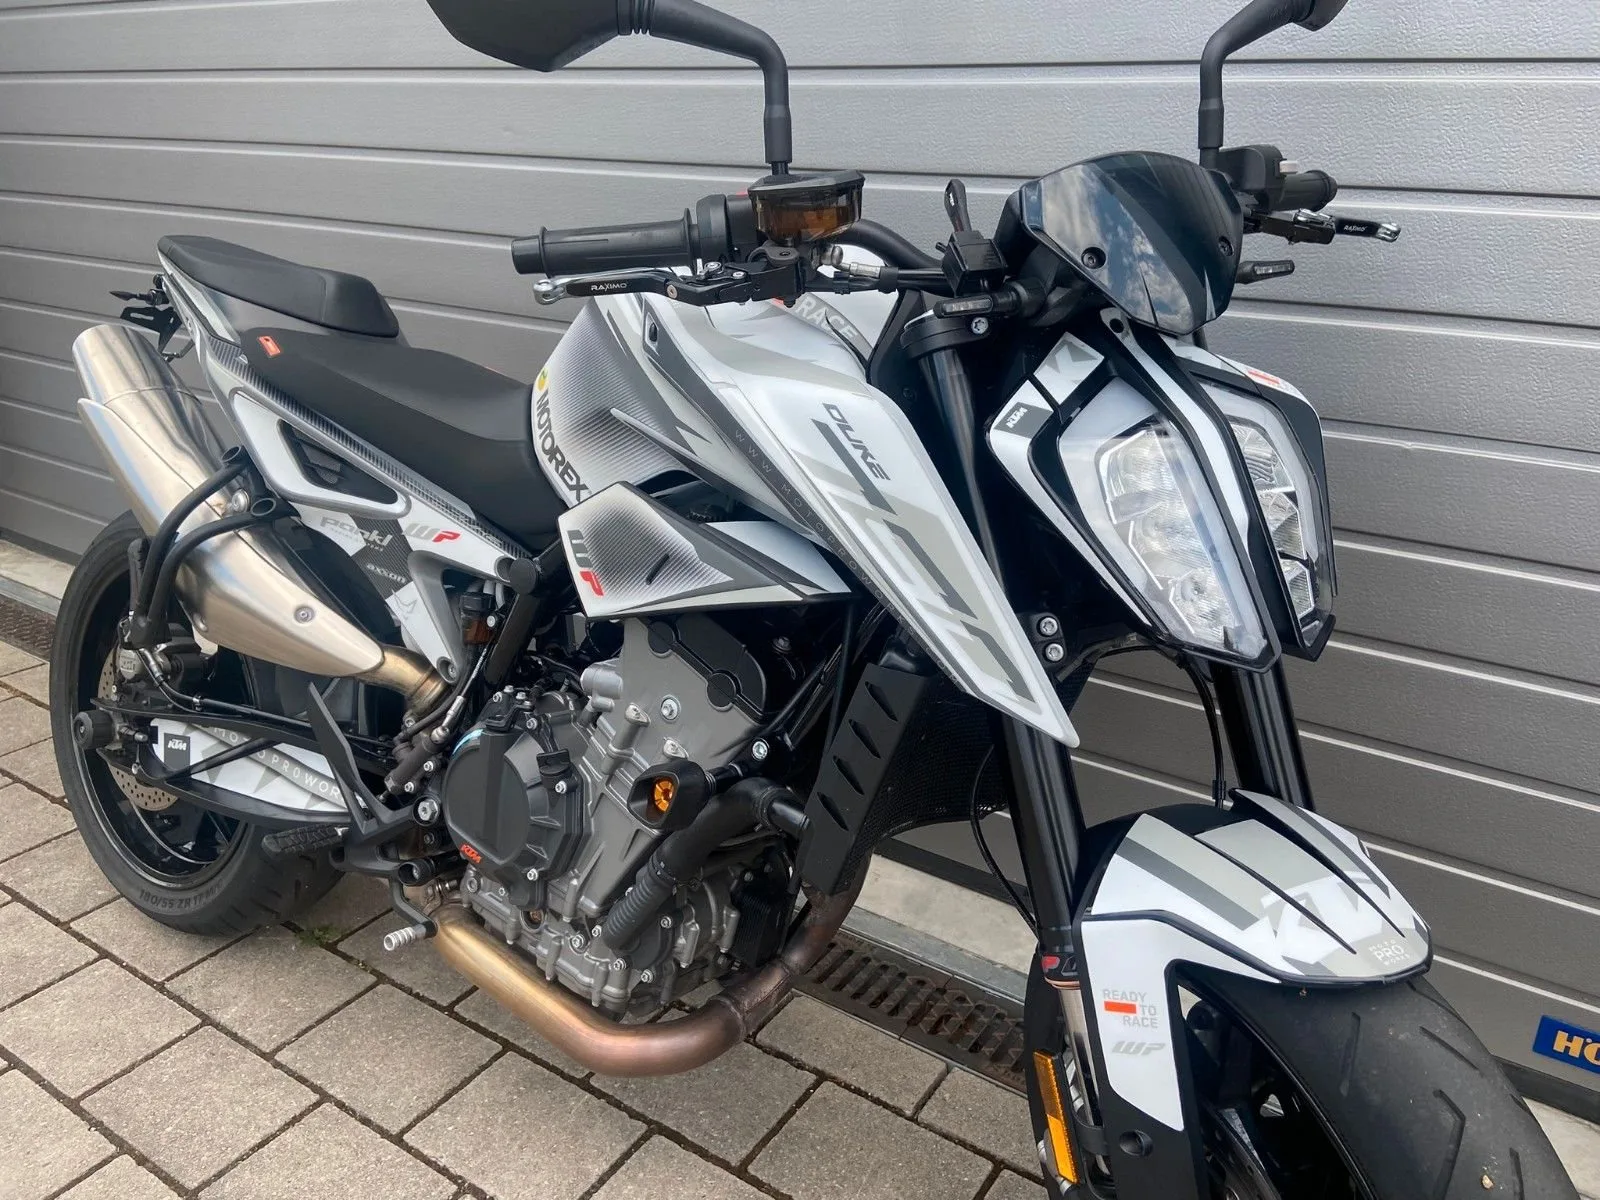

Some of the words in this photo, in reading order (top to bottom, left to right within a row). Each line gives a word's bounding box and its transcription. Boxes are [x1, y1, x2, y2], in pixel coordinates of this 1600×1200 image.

[590, 282, 628, 292] RAXIMO
[795, 296, 859, 338] RACE
[1005, 407, 1028, 429] KTM
[536, 391, 589, 502] MOTOREX
[822, 403, 891, 481] DUKE
[404, 523, 461, 543] WP
[567, 529, 604, 597] WP
[167, 739, 187, 751] KTM
[1374, 944, 1405, 961] PRO
[1102, 989, 1147, 1003] READY
[1139, 1005, 1157, 1017] TO
[1122, 1015, 1159, 1029] RACE
[1111, 1040, 1166, 1056] WP
